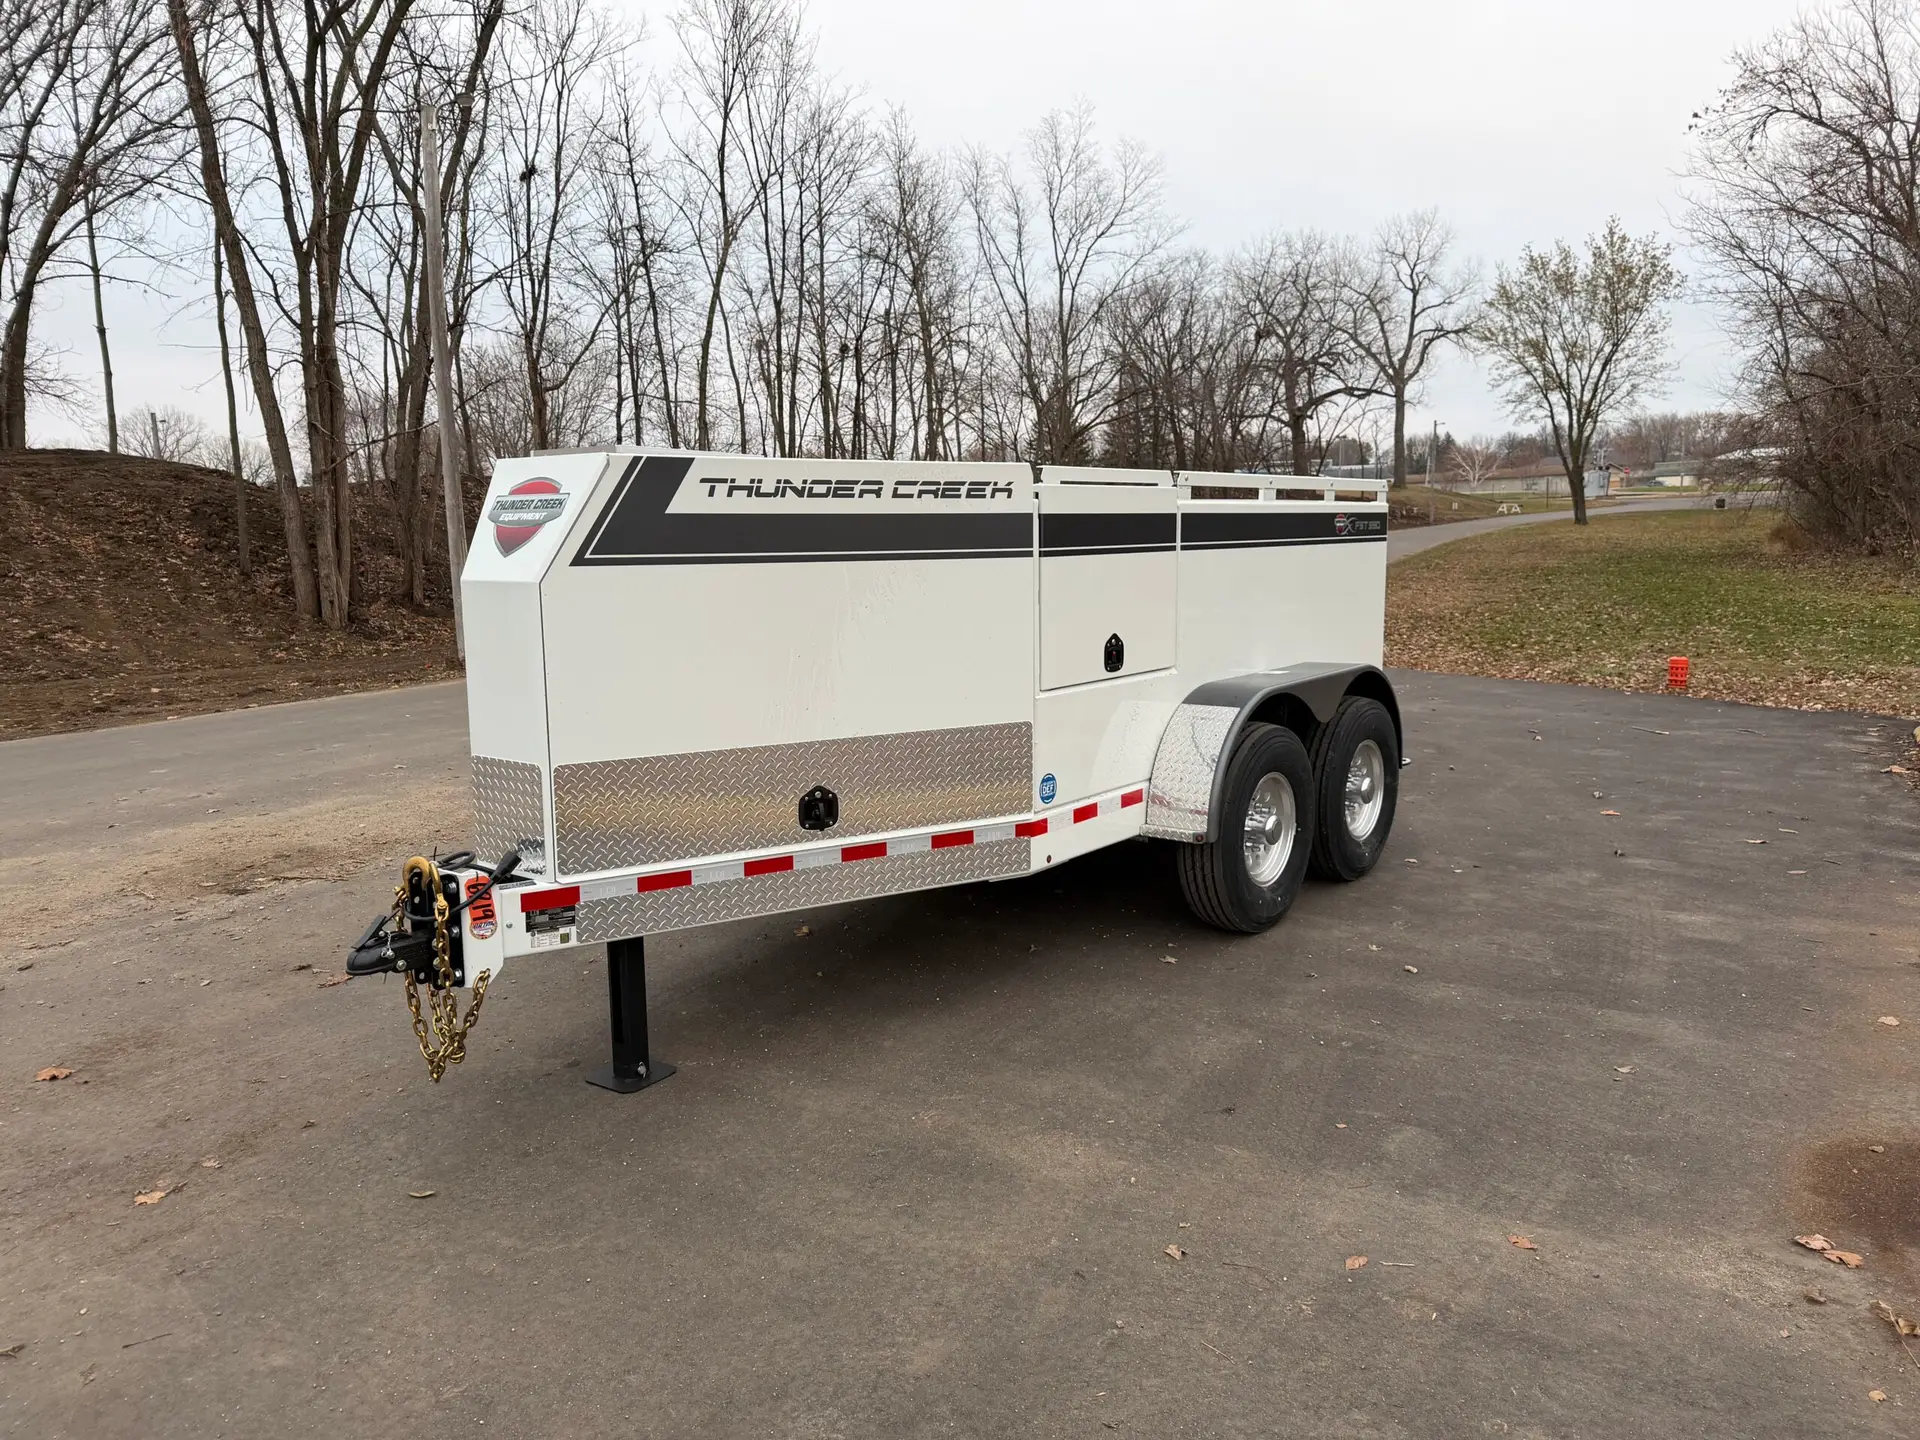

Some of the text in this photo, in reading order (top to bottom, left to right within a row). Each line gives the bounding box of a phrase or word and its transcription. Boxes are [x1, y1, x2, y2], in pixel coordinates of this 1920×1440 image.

[699, 478, 1015, 500] THUNDER CREEK
[493, 498, 566, 511] THUNDER CREEK
[499, 512, 547, 522] EQUIPMENT
[1042, 783, 1054, 794] DEF
